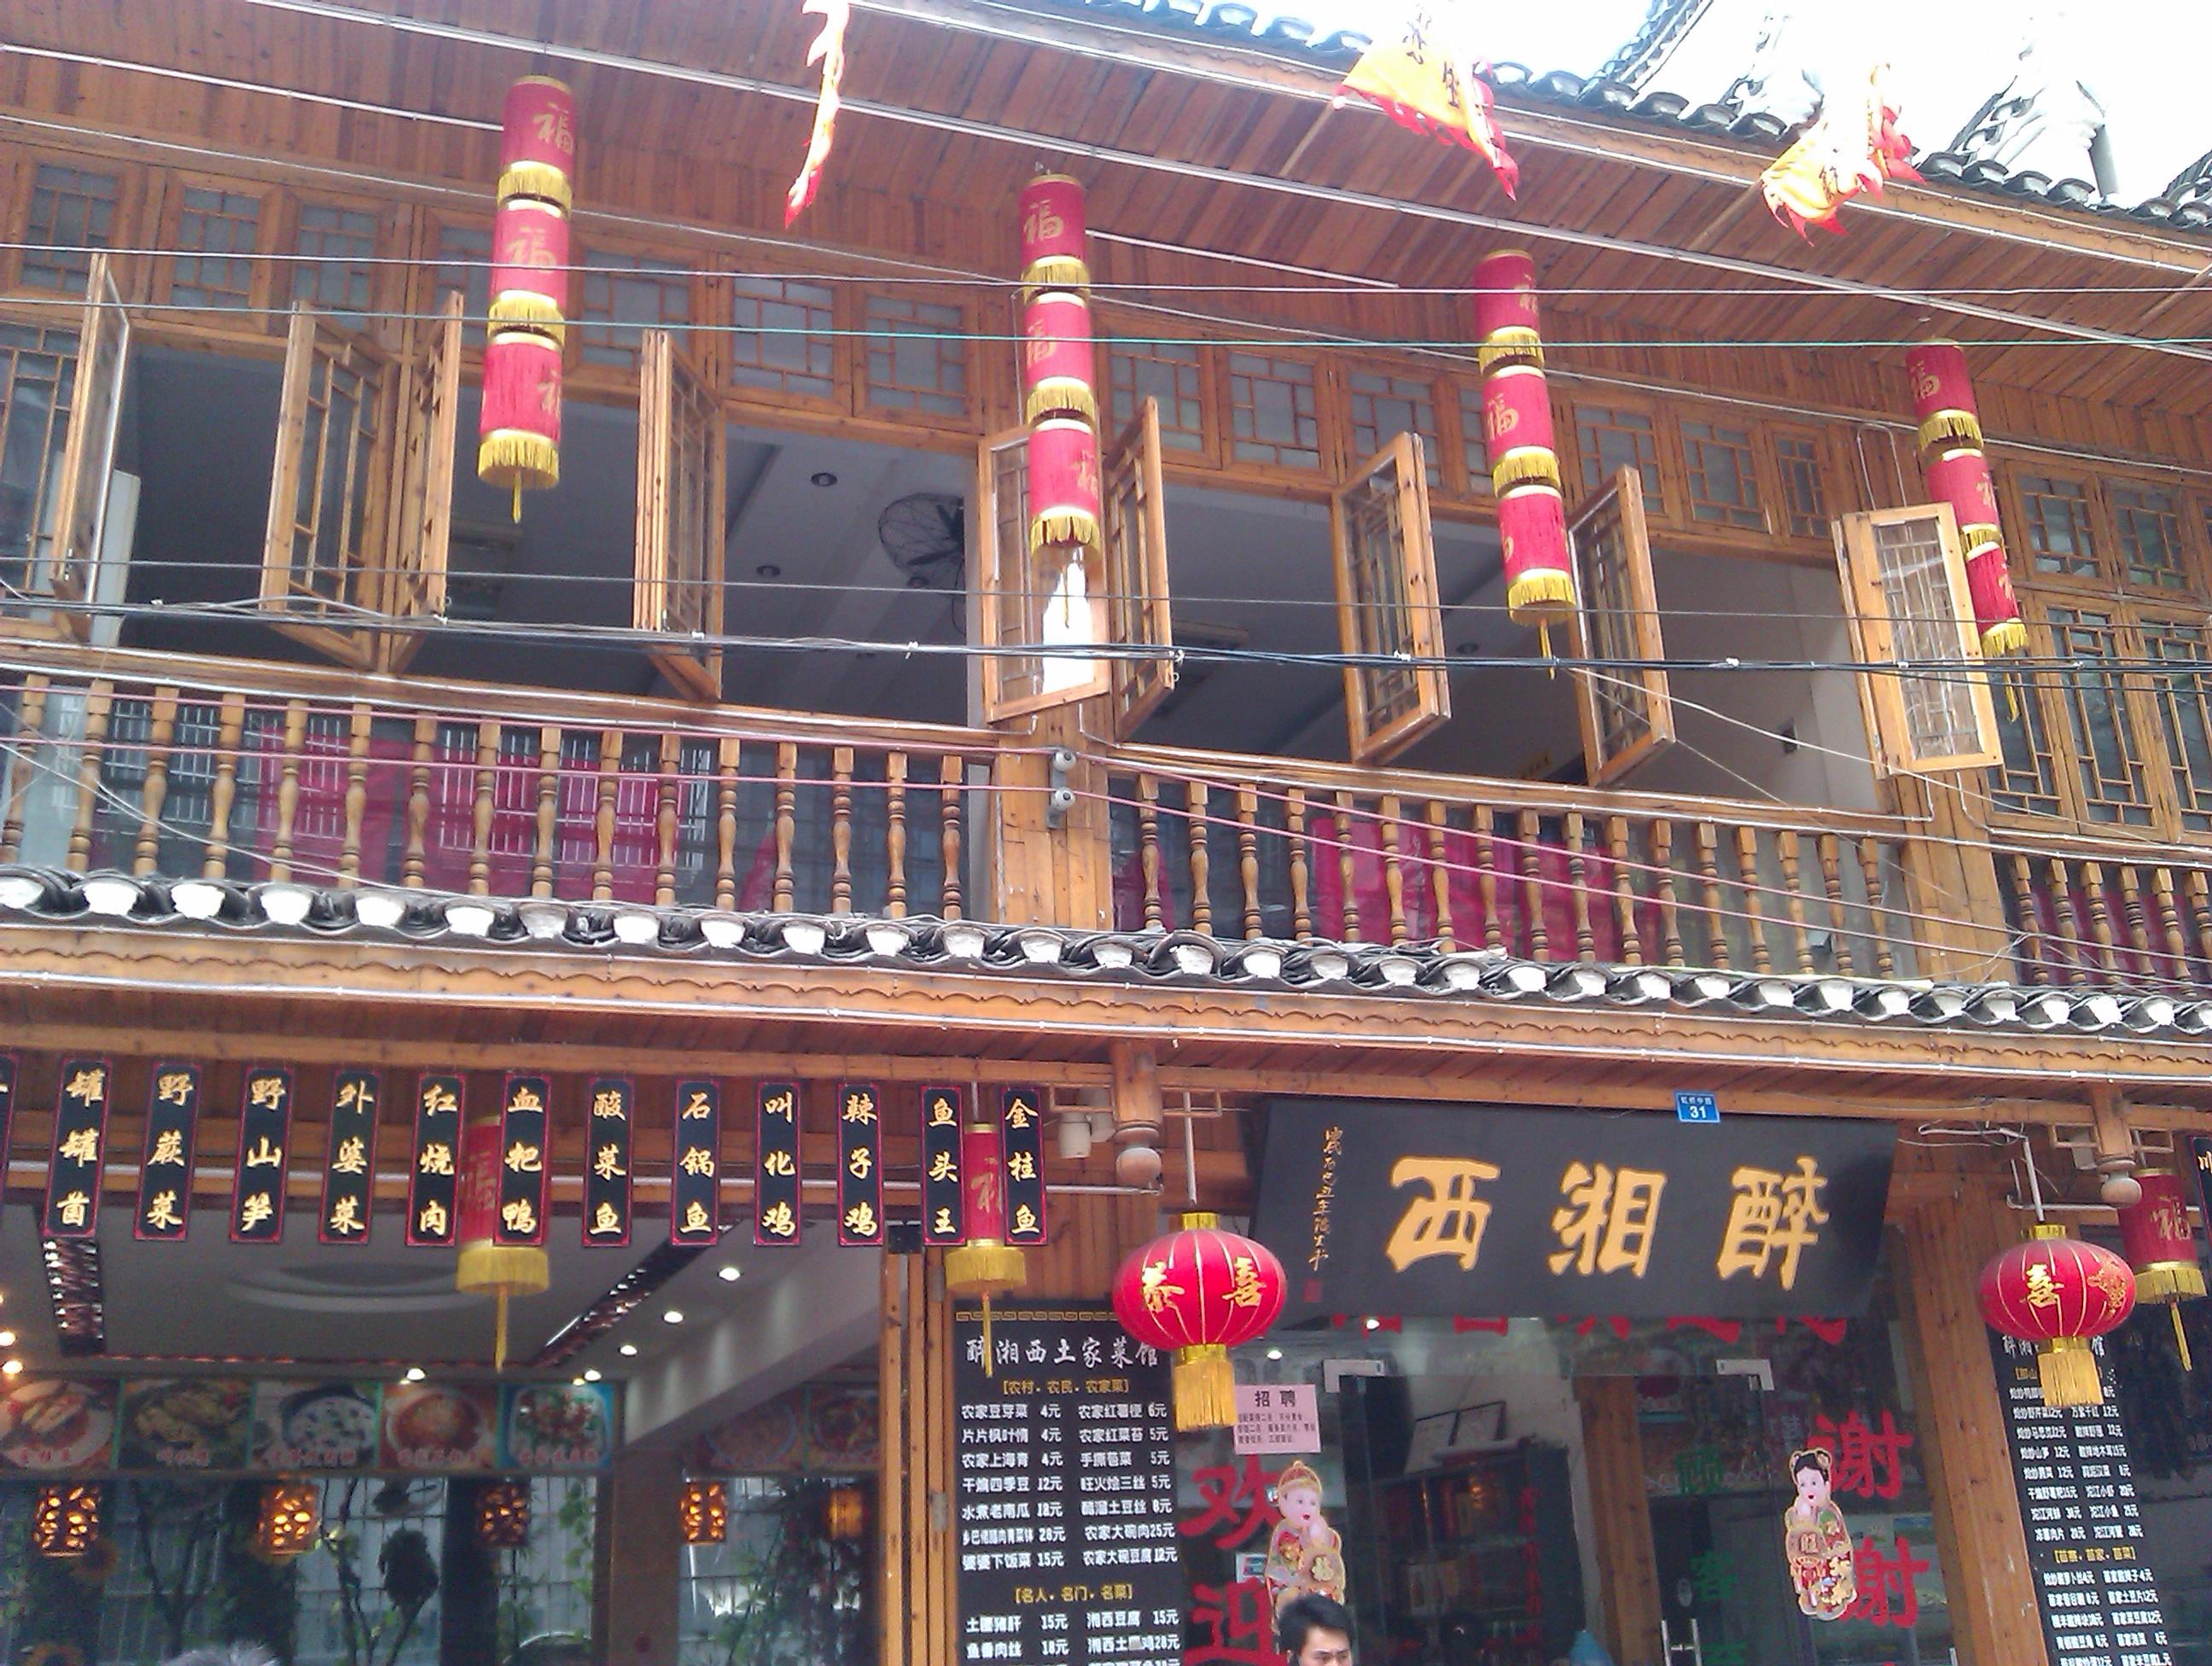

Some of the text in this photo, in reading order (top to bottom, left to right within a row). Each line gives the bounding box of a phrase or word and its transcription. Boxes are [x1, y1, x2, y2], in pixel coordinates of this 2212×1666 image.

[1690, 1105, 1707, 1119] 31
[145, 1072, 195, 1231] 野蕨菜
[329, 1078, 375, 1234] 外婆菜
[418, 1084, 458, 1236] 红烧肉
[590, 1090, 626, 1237] 酸菜鱼
[679, 1093, 715, 1234] 石锅鱼
[762, 1091, 796, 1237] 叫化鸡
[841, 1094, 878, 1238] 辣子鸡
[928, 1097, 959, 1237] 鱼头王
[1004, 1097, 1040, 1235] 金桂鱼
[1040, 1404, 1061, 1418] 4元
[1041, 1428, 1061, 1442] 4元
[1150, 1427, 1168, 1441] 5元
[1042, 1452, 1062, 1465] 4元
[1151, 1451, 1170, 1465] 5元
[1038, 1477, 1062, 1490] 12元
[1152, 1475, 1171, 1488] 5元
[1038, 1552, 1064, 1566] 15元
[1041, 1614, 1068, 1629] 15元
[1153, 1610, 1179, 1625] 15元
